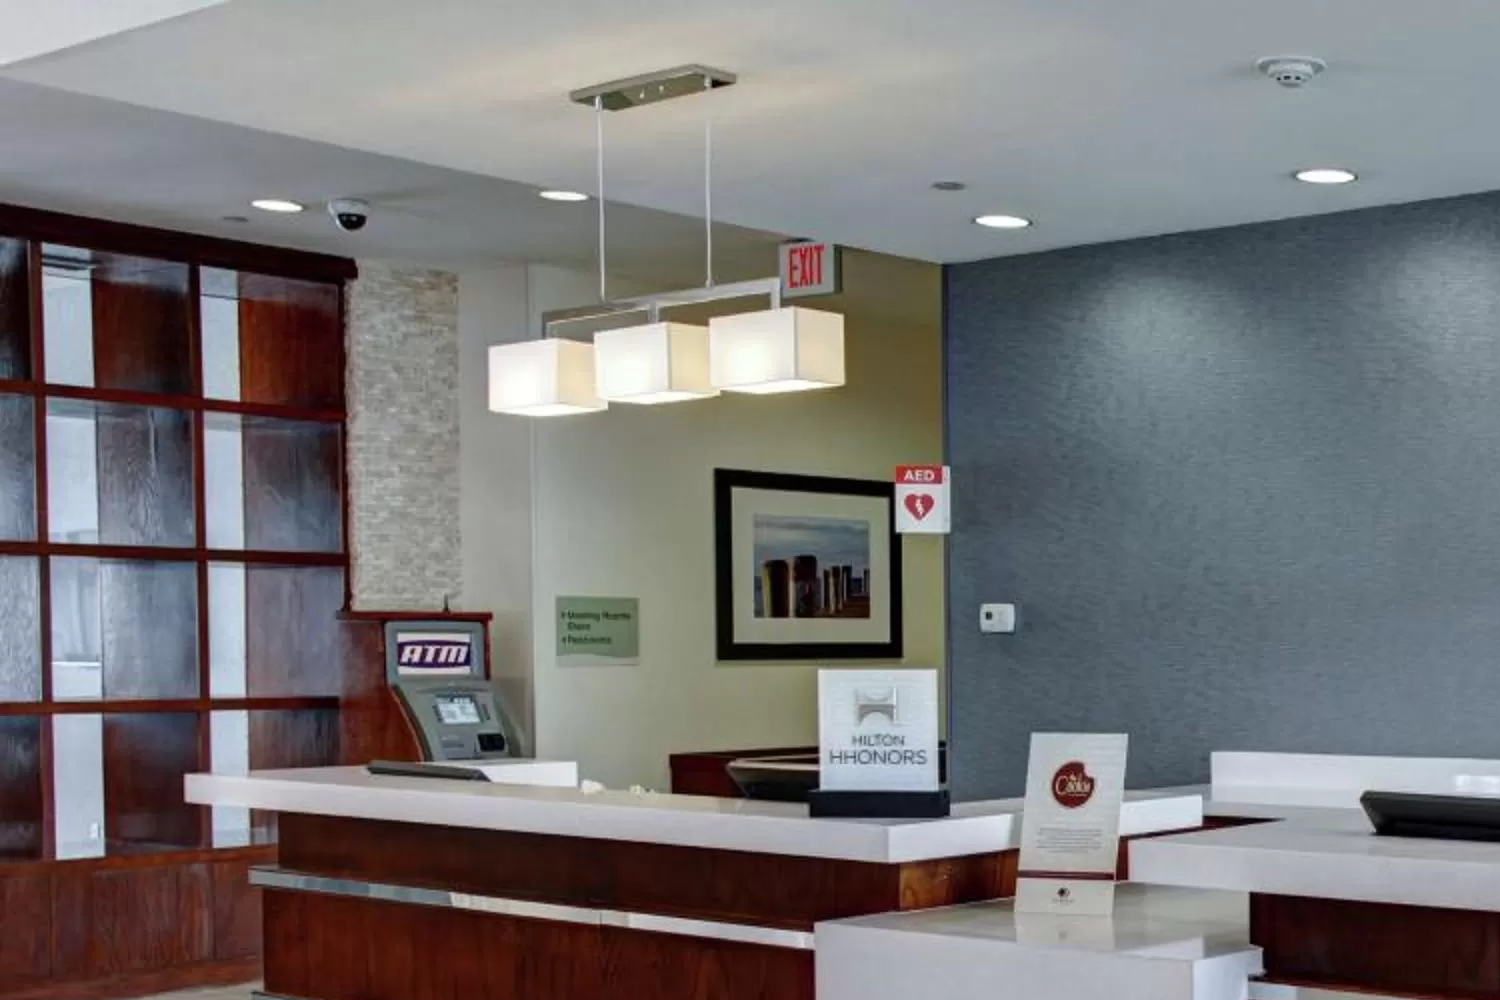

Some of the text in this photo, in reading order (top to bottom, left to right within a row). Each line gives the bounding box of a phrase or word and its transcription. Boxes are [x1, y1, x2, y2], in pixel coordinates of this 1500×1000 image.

[788, 244, 825, 289] EXIT
[903, 469, 935, 481] AED
[401, 645, 469, 664] ATM
[851, 732, 905, 747] HILTON
[829, 749, 928, 765] HHONORS
